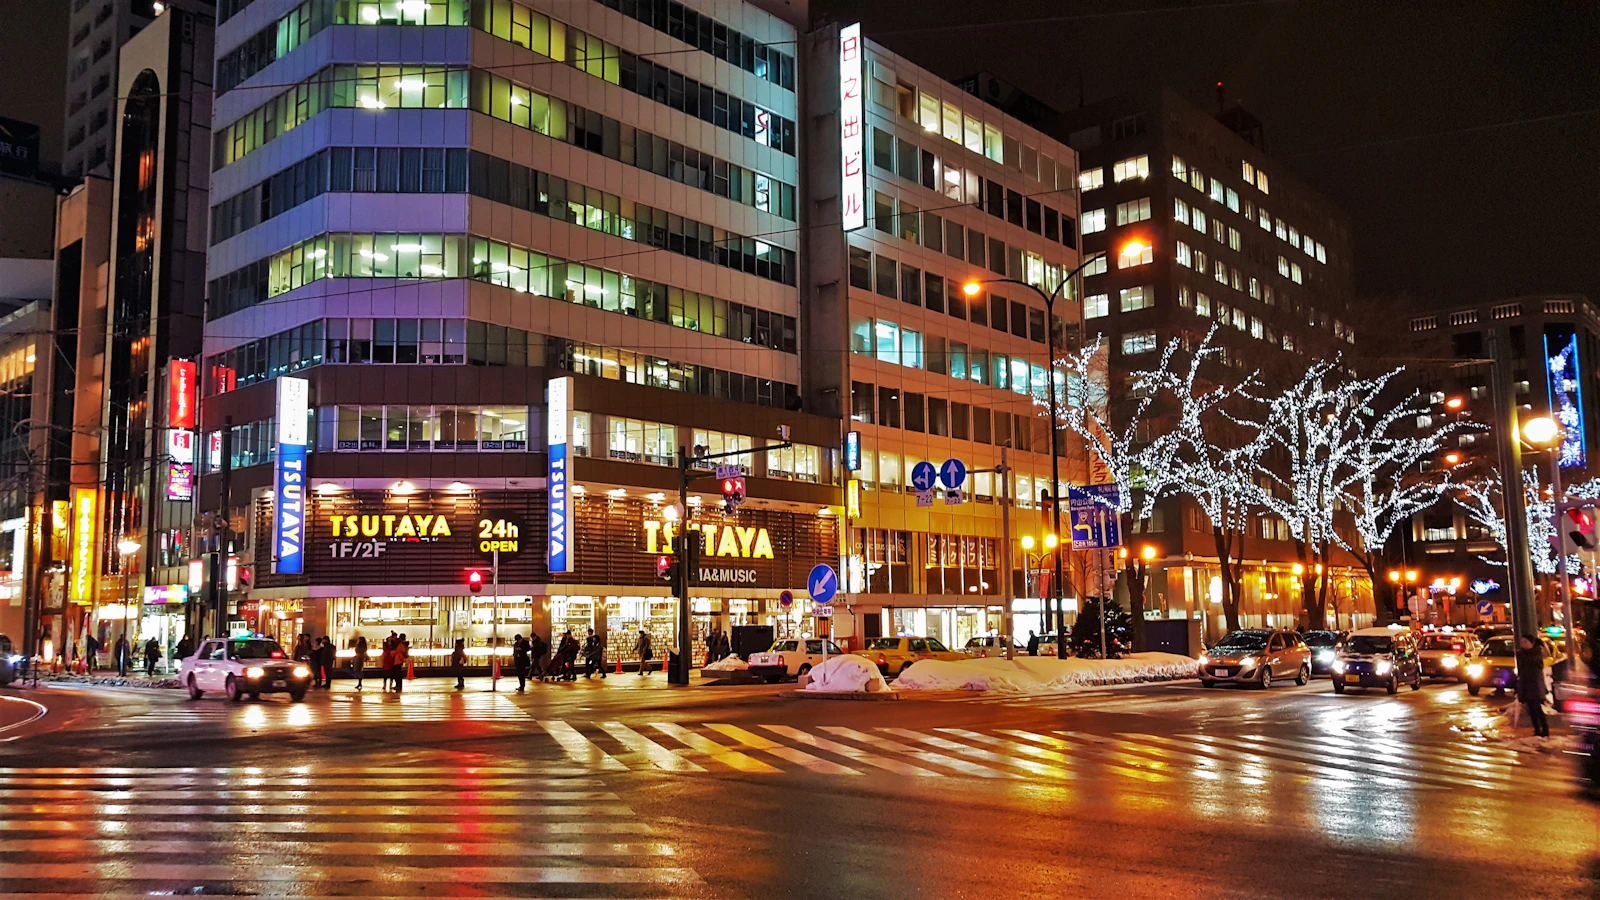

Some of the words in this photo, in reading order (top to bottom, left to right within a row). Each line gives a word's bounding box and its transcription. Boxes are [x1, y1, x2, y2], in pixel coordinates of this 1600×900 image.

[843, 36, 861, 217] 日之出ビル
[281, 459, 302, 558] TSUTAYA
[551, 458, 565, 557] TSUTAYA
[916, 494, 933, 504] 7-22
[329, 514, 452, 537] TSUTAYA
[479, 519, 519, 539] 24h
[329, 542, 387, 558] 1F/2F
[480, 540, 518, 553] OPEN
[643, 520, 775, 559] TSTAYA
